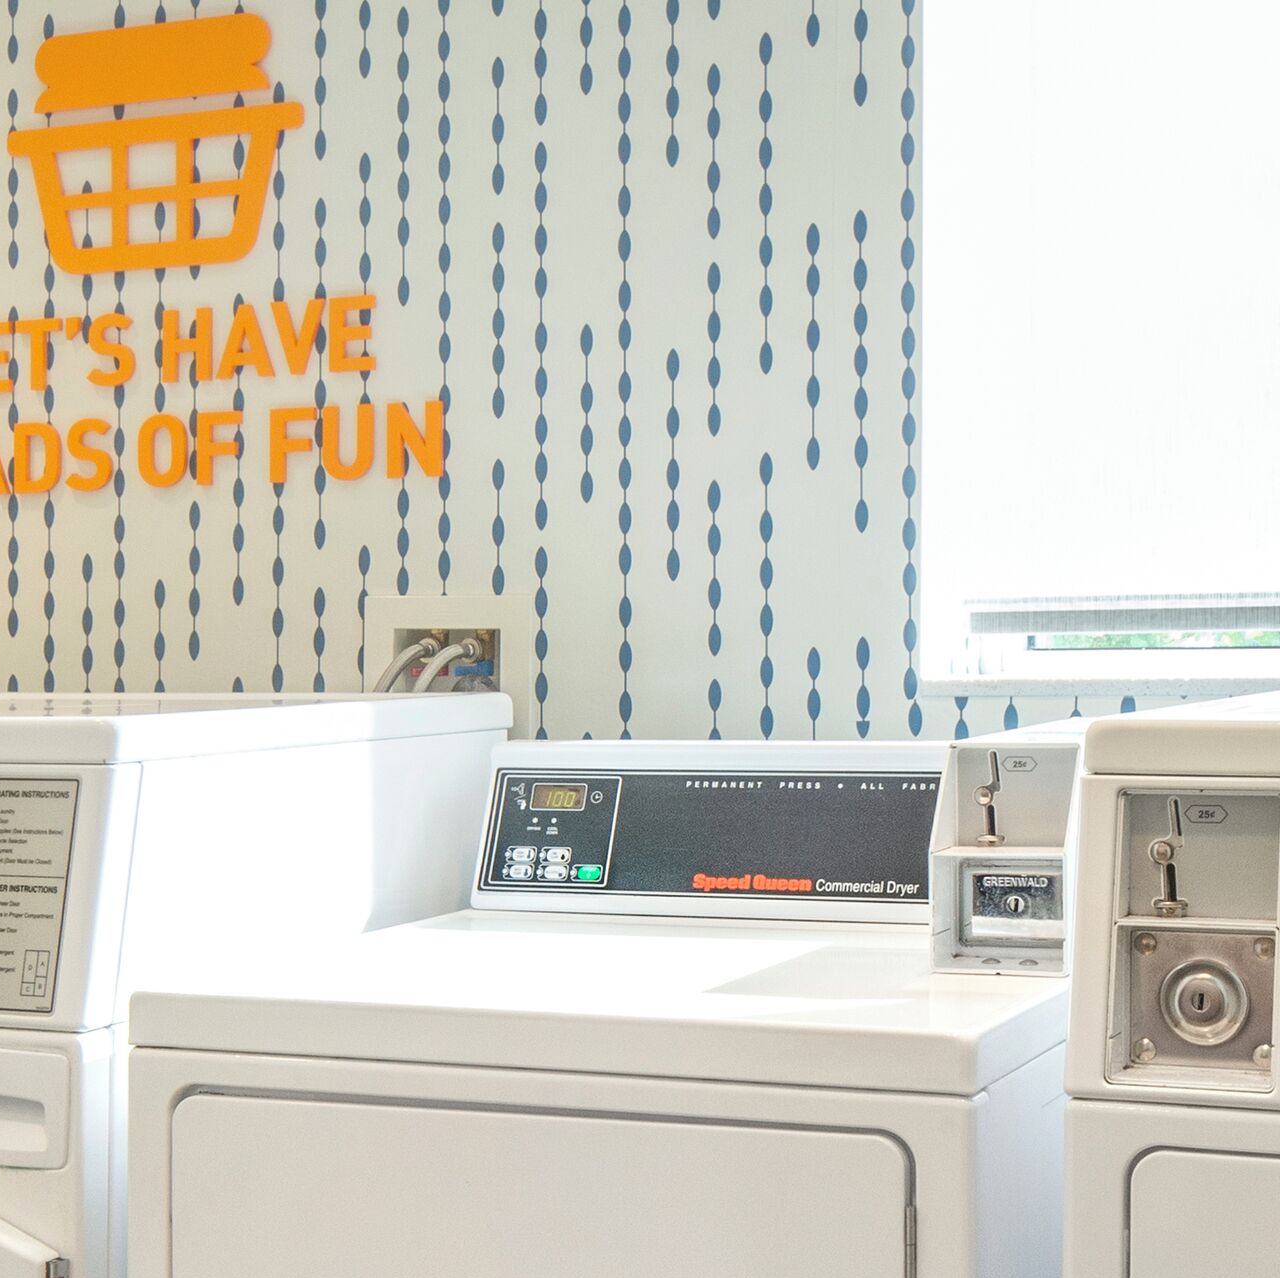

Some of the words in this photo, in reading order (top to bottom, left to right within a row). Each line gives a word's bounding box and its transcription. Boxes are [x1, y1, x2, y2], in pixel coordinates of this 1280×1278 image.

[161, 294, 377, 384] HAVE
[137, 411, 243, 488] OF
[269, 401, 445, 484] FUN
[686, 781, 763, 789] PERMANENT
[779, 782, 821, 790] PRESS
[21, 791, 70, 799] INSTRUCTIONS
[545, 791, 577, 807] 100
[9, 885, 58, 893] INSTRUCTIONS
[693, 873, 751, 892] Speed
[753, 874, 813, 892] Queen
[816, 878, 884, 894] Commercial
[886, 880, 920, 896] Dryer
[983, 876, 1049, 888] GREENWALD
